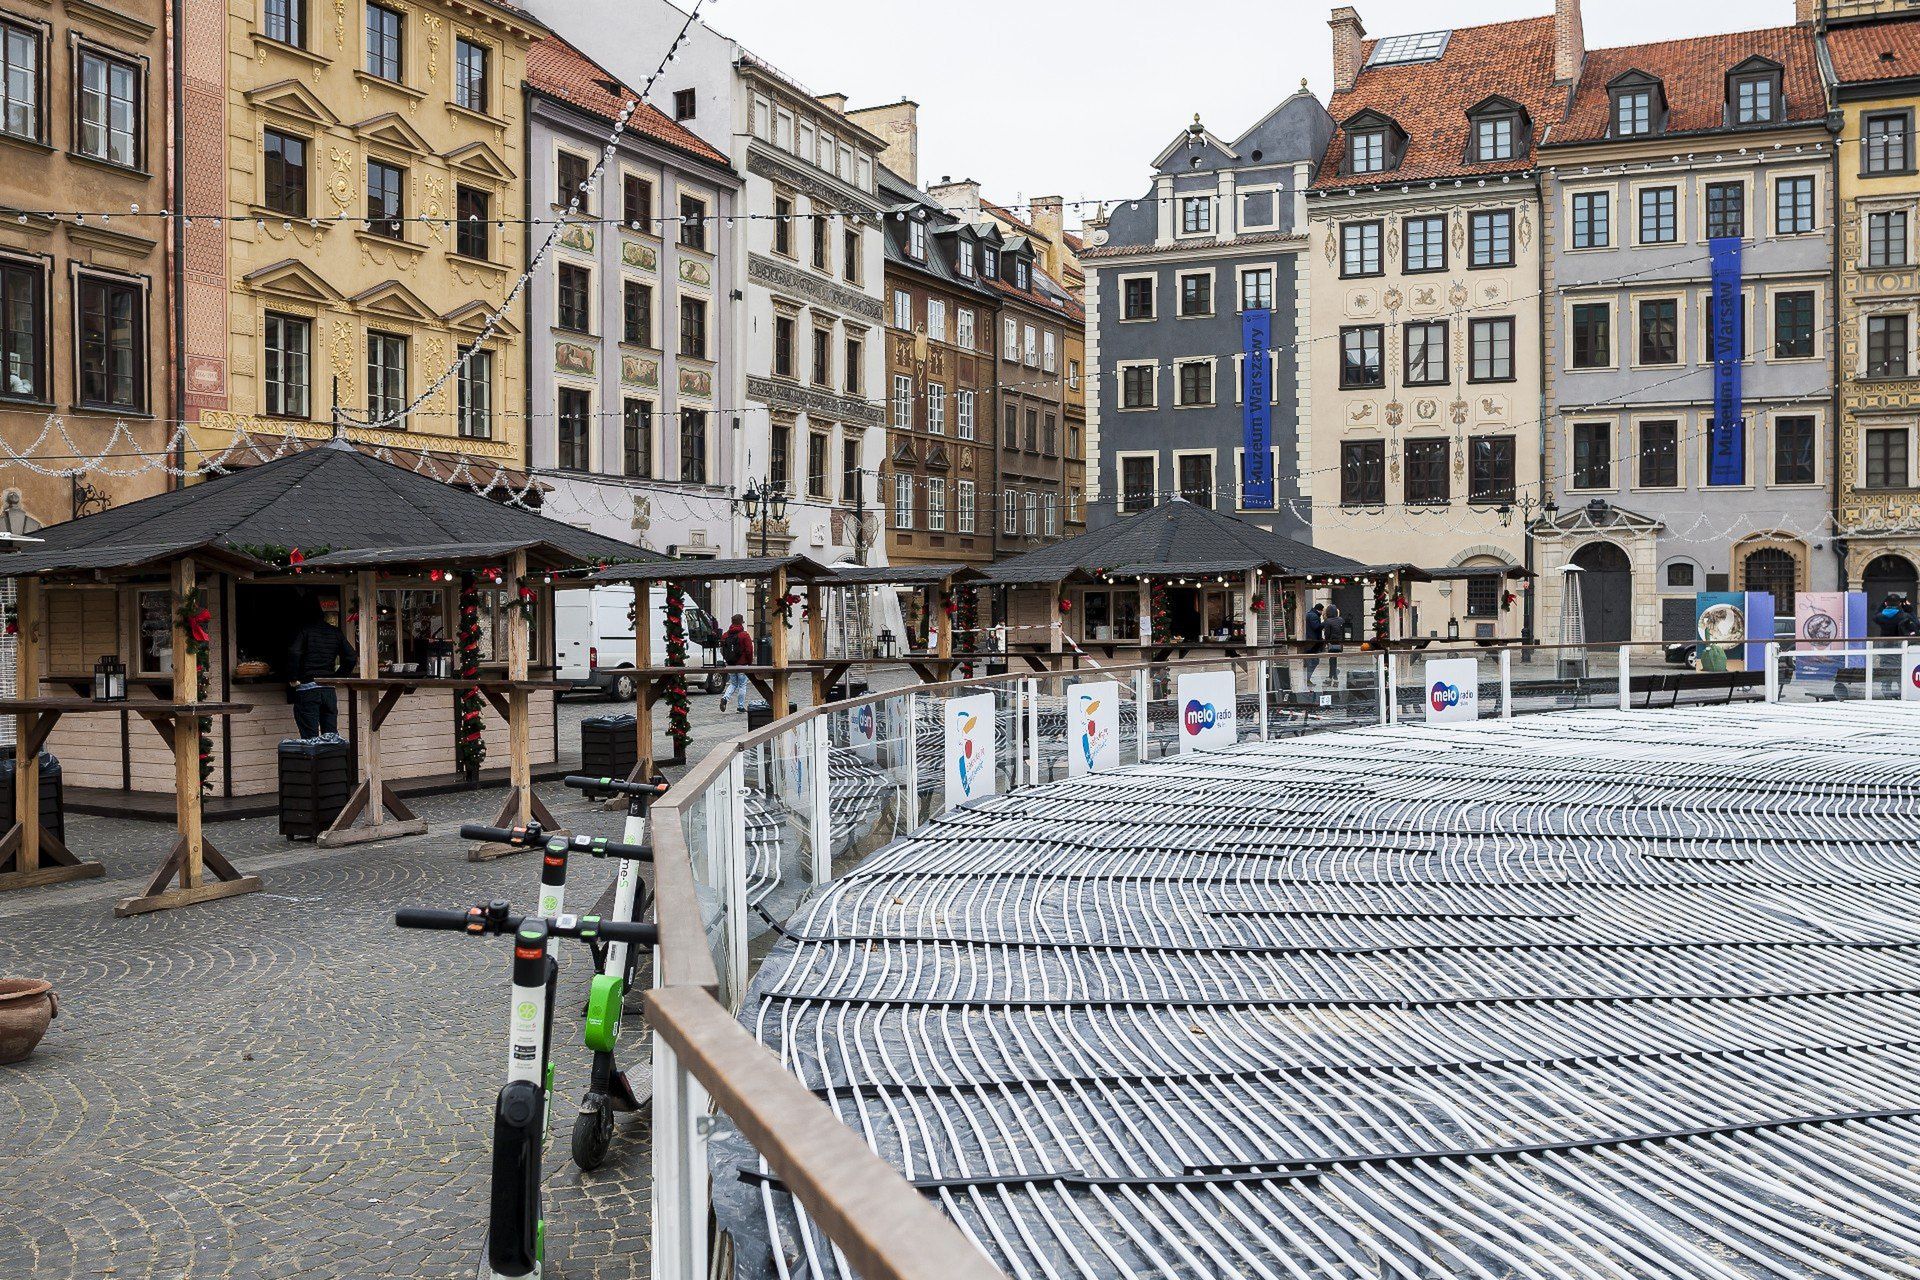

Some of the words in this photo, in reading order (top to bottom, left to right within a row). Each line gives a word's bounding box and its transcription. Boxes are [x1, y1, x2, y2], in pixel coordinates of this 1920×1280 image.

[1717, 282, 1733, 355] Warsaw
[1249, 328, 1264, 413] Warszawy
[1250, 417, 1263, 484] Muzeum
[1718, 382, 1733, 456] Museum
[1187, 709, 1213, 724] melo
[1216, 709, 1232, 720] radio
[1434, 690, 1456, 703] melo
[1460, 690, 1474, 699] radio
